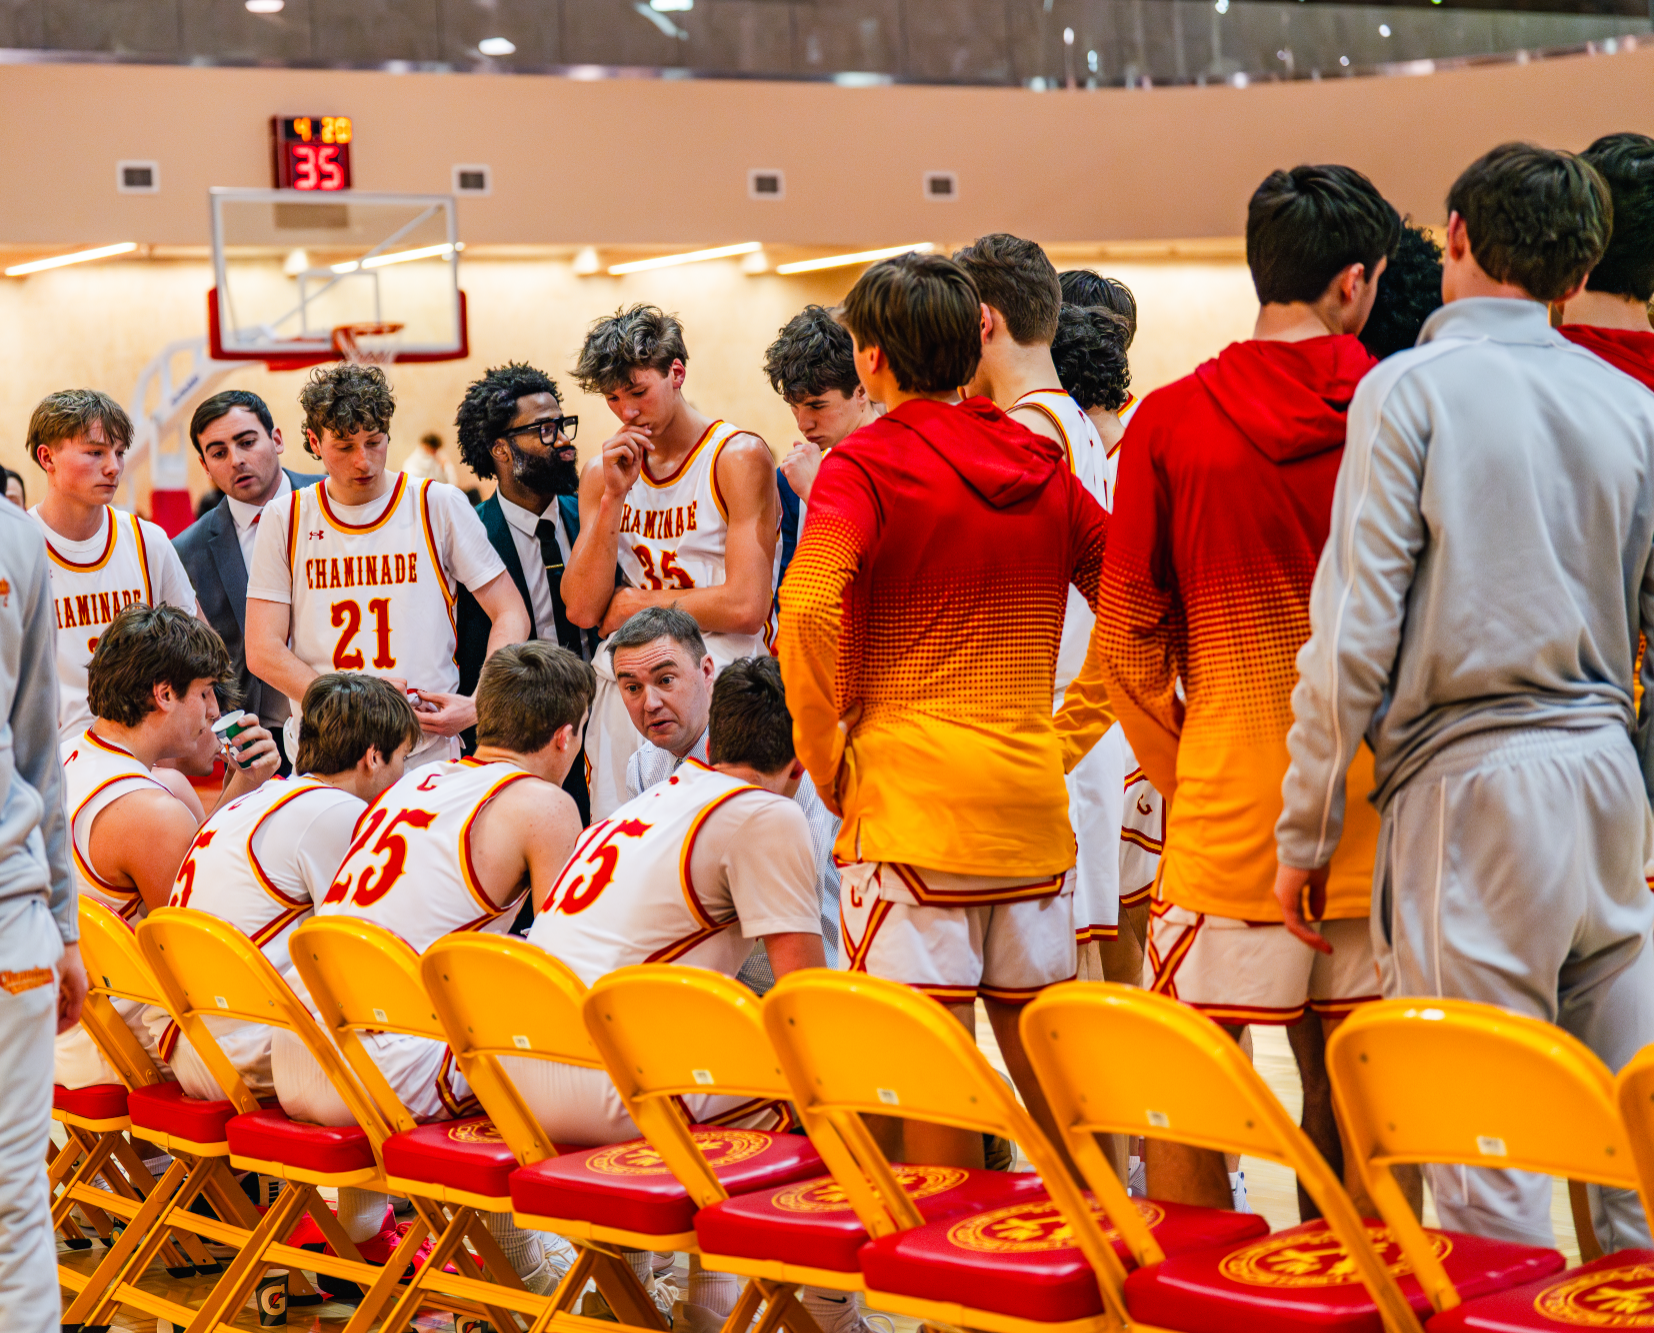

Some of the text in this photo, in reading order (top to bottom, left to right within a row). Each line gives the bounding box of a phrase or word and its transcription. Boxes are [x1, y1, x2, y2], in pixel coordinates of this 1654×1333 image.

[292, 145, 344, 191] 35
[305, 552, 418, 590] CHAMINADE
[631, 543, 695, 590] 35
[330, 597, 397, 671] 21
[320, 807, 440, 909] 25
[541, 817, 656, 916] 15
[260, 1283, 286, 1316] G
